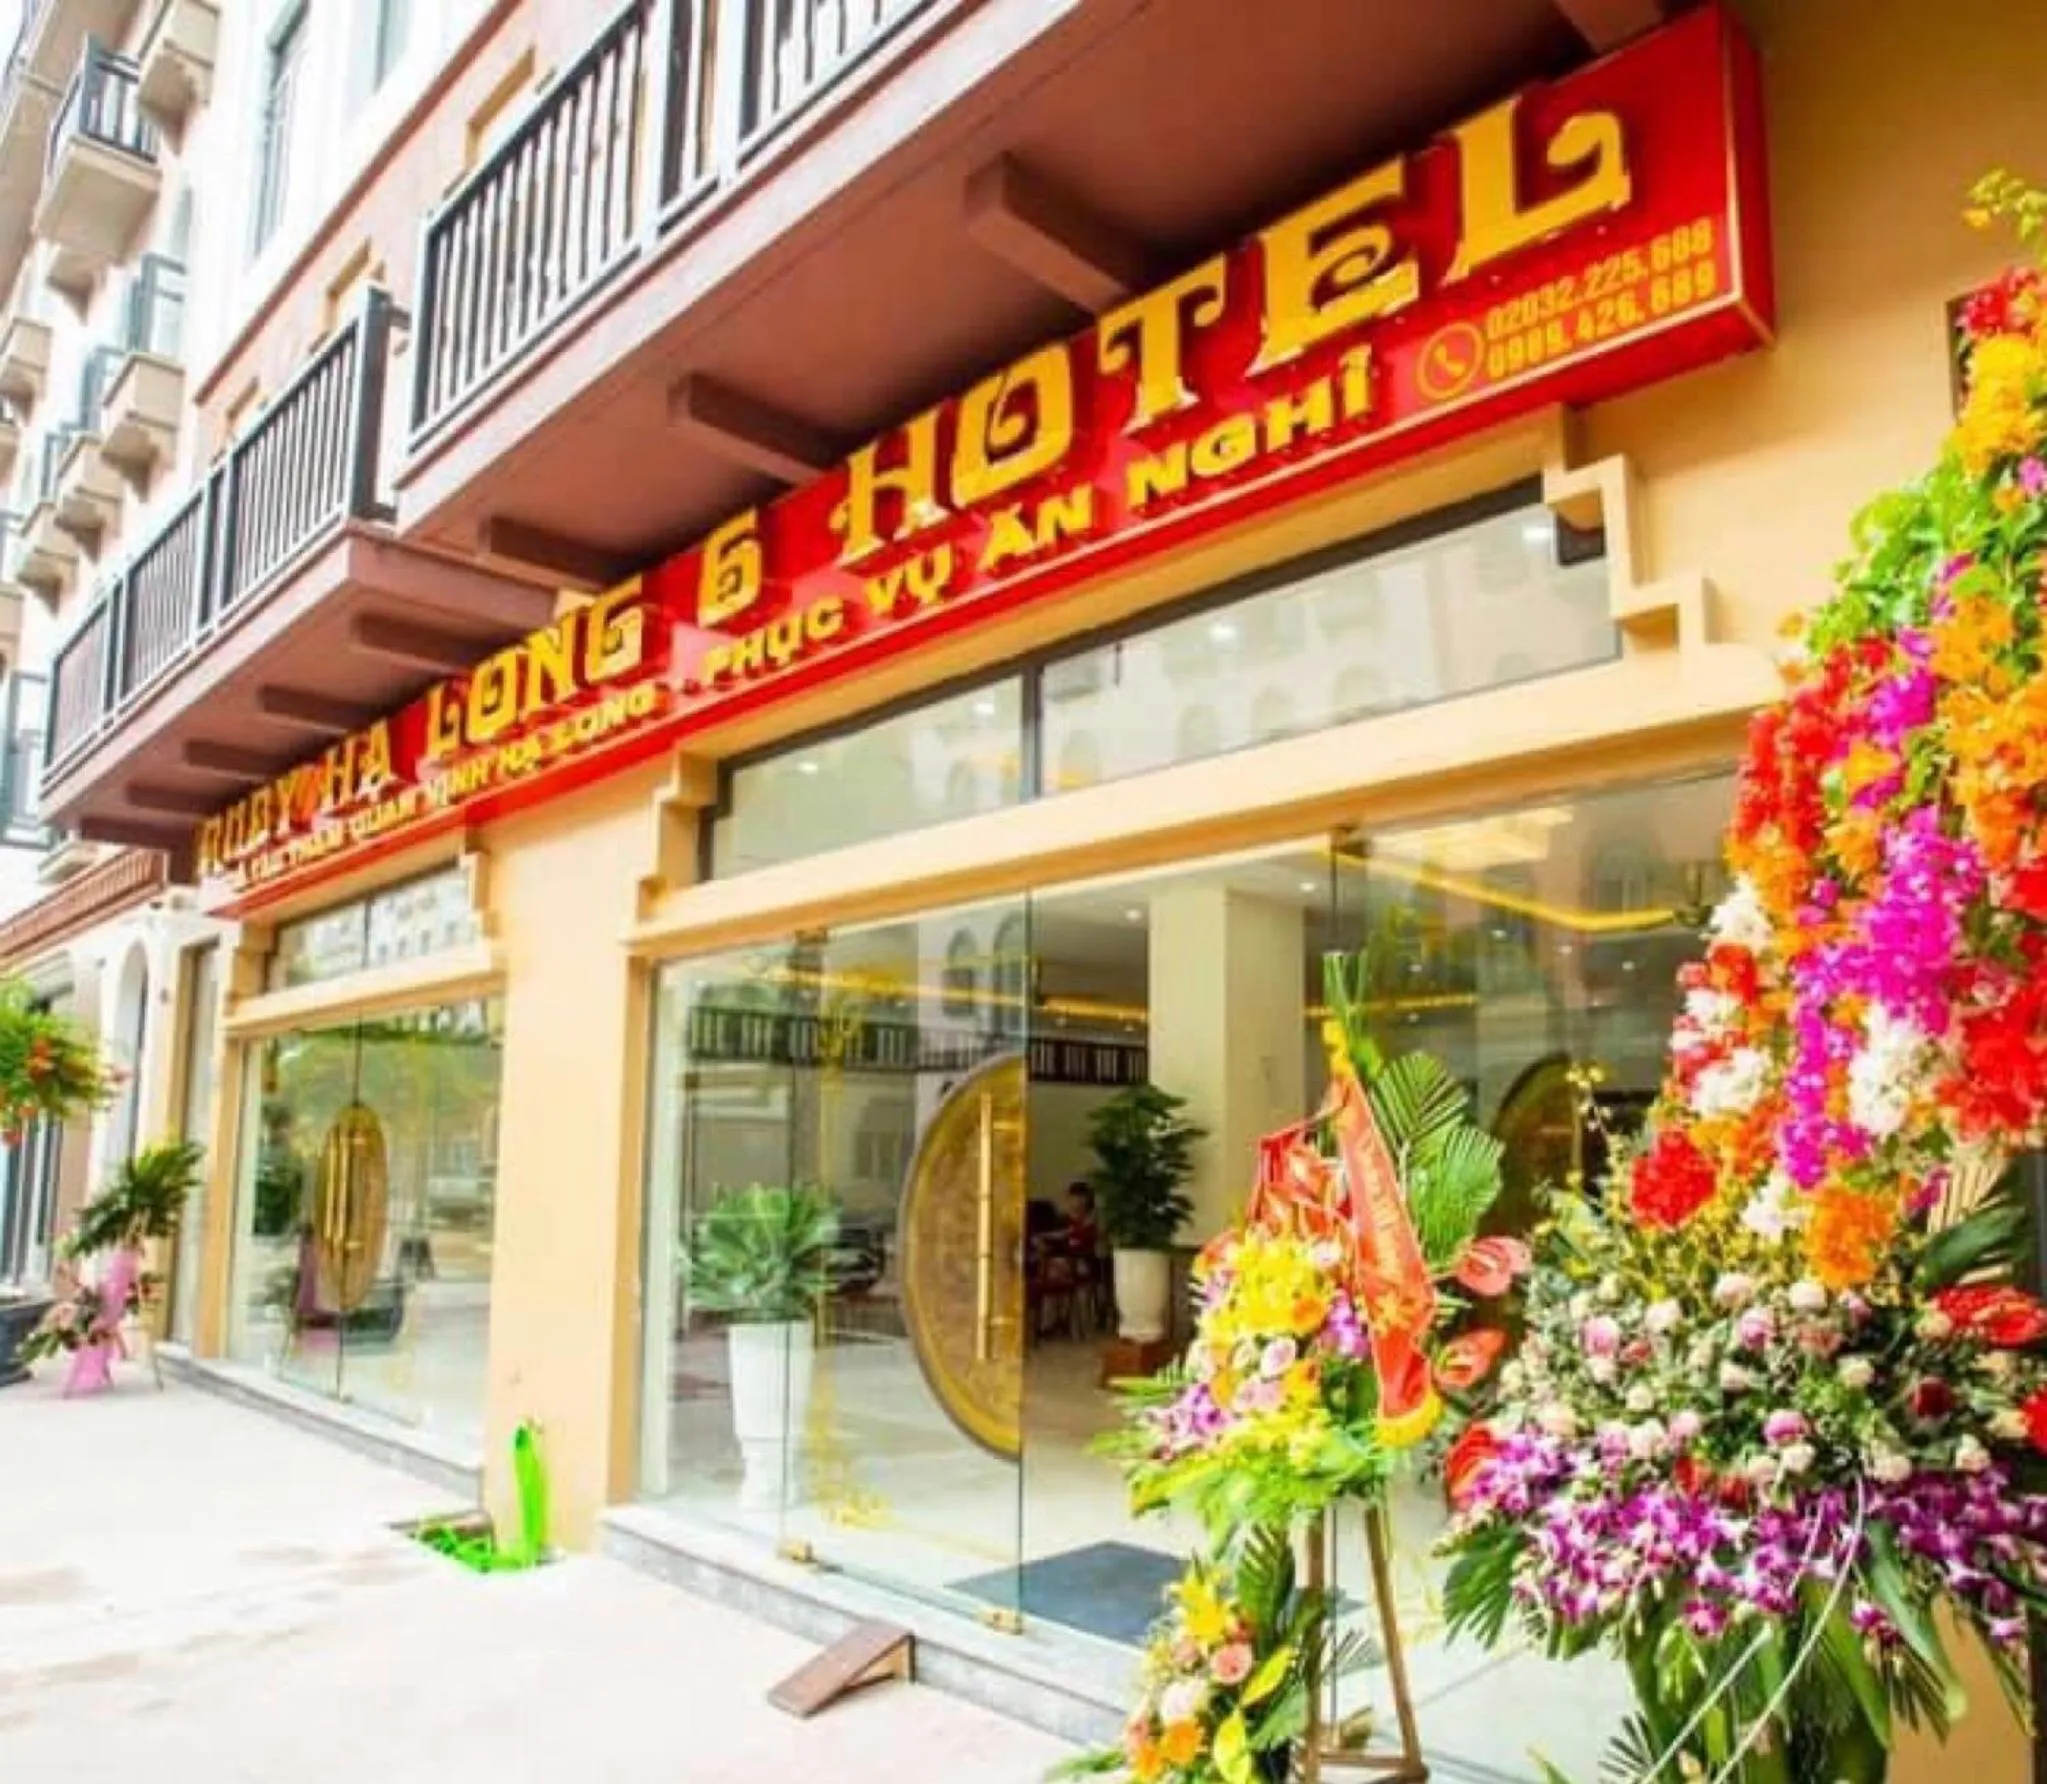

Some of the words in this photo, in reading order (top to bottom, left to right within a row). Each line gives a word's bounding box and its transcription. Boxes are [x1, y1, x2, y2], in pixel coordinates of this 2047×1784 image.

[427, 573, 644, 760] LONG
[829, 95, 1632, 567] HOTEL
[704, 595, 844, 685] PHỤC
[865, 542, 952, 616] VỤ
